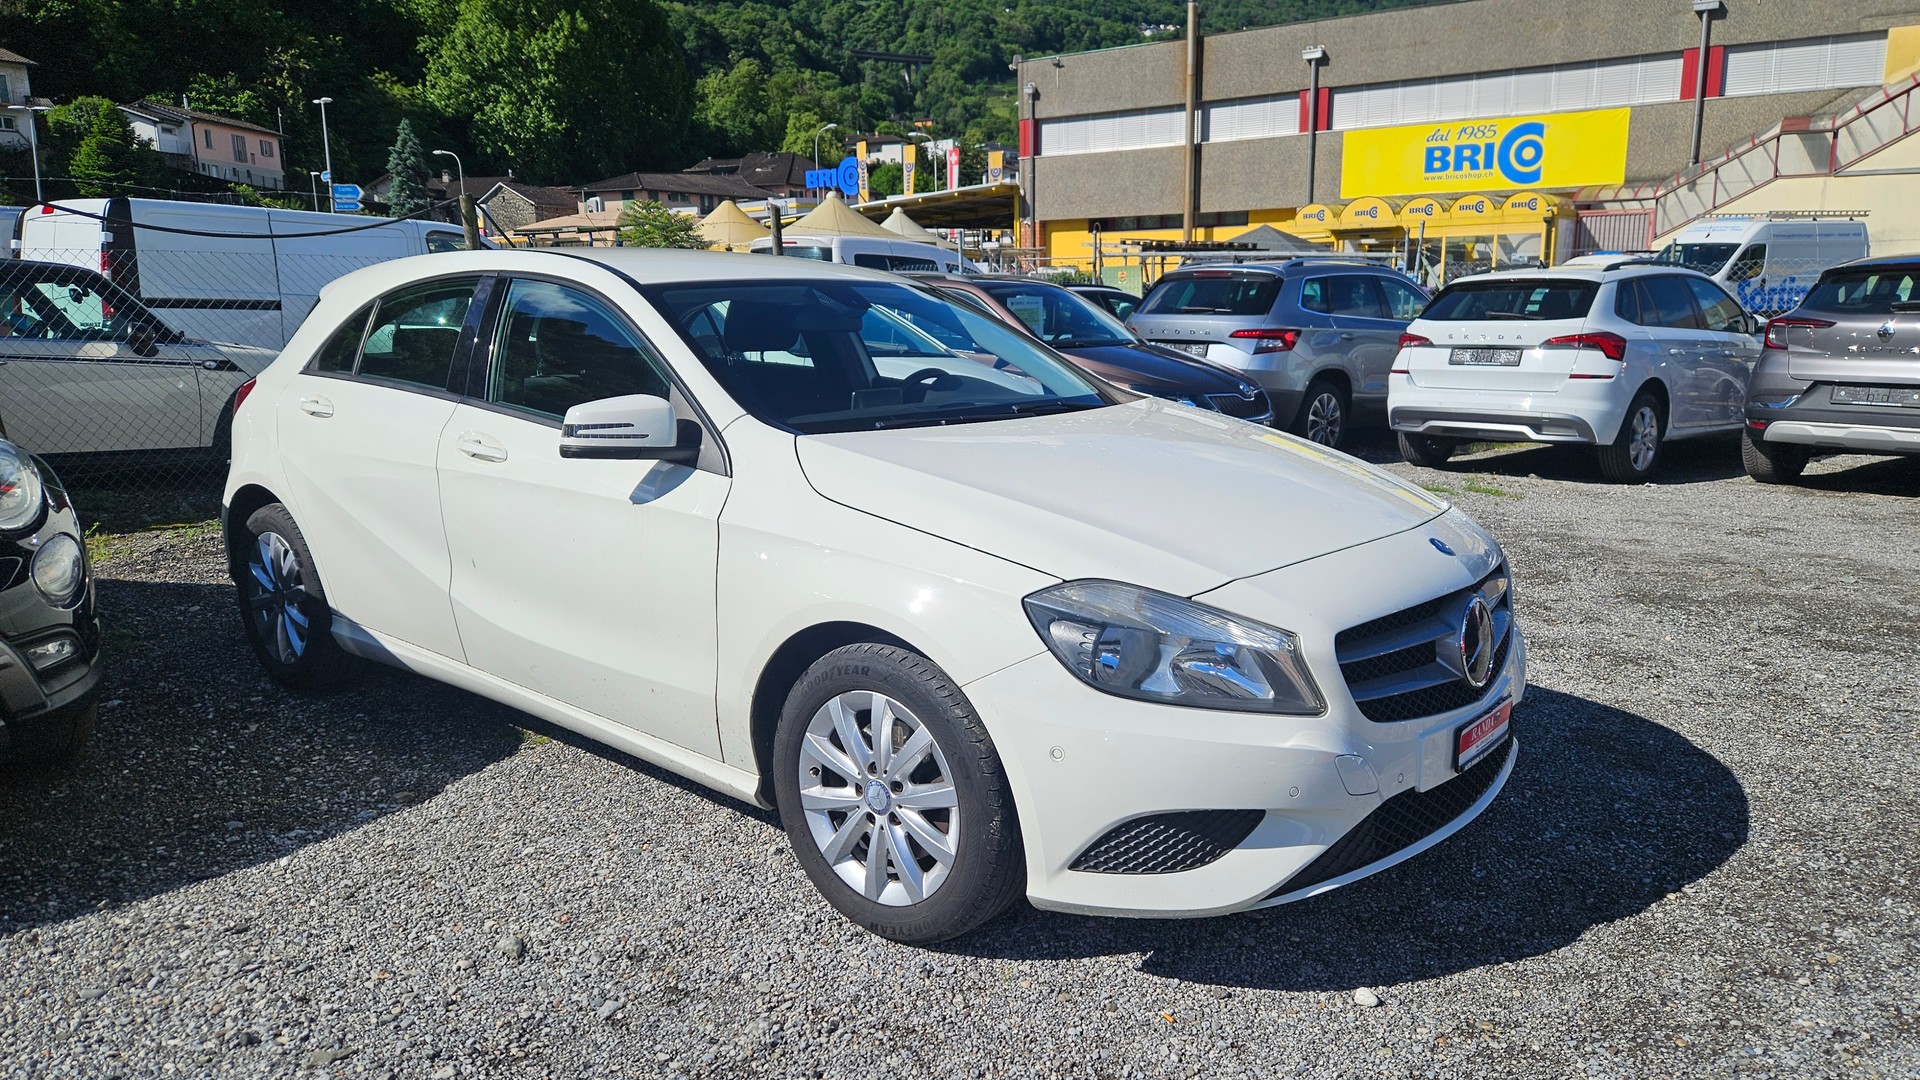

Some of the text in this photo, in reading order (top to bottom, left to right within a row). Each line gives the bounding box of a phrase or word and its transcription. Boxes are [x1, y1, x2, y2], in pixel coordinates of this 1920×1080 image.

[1426, 124, 1498, 142] dal 1985
[1424, 122, 1545, 184] BRICO
[805, 156, 858, 196] BRICO
[1423, 172, 1494, 181] www.bricoshop.ch
[1408, 203, 1434, 216] BRICO
[1458, 200, 1485, 213] BRICO
[1512, 197, 1538, 211] BRICO
[1302, 209, 1325, 222] BRICO
[1354, 206, 1378, 219] BRICO
